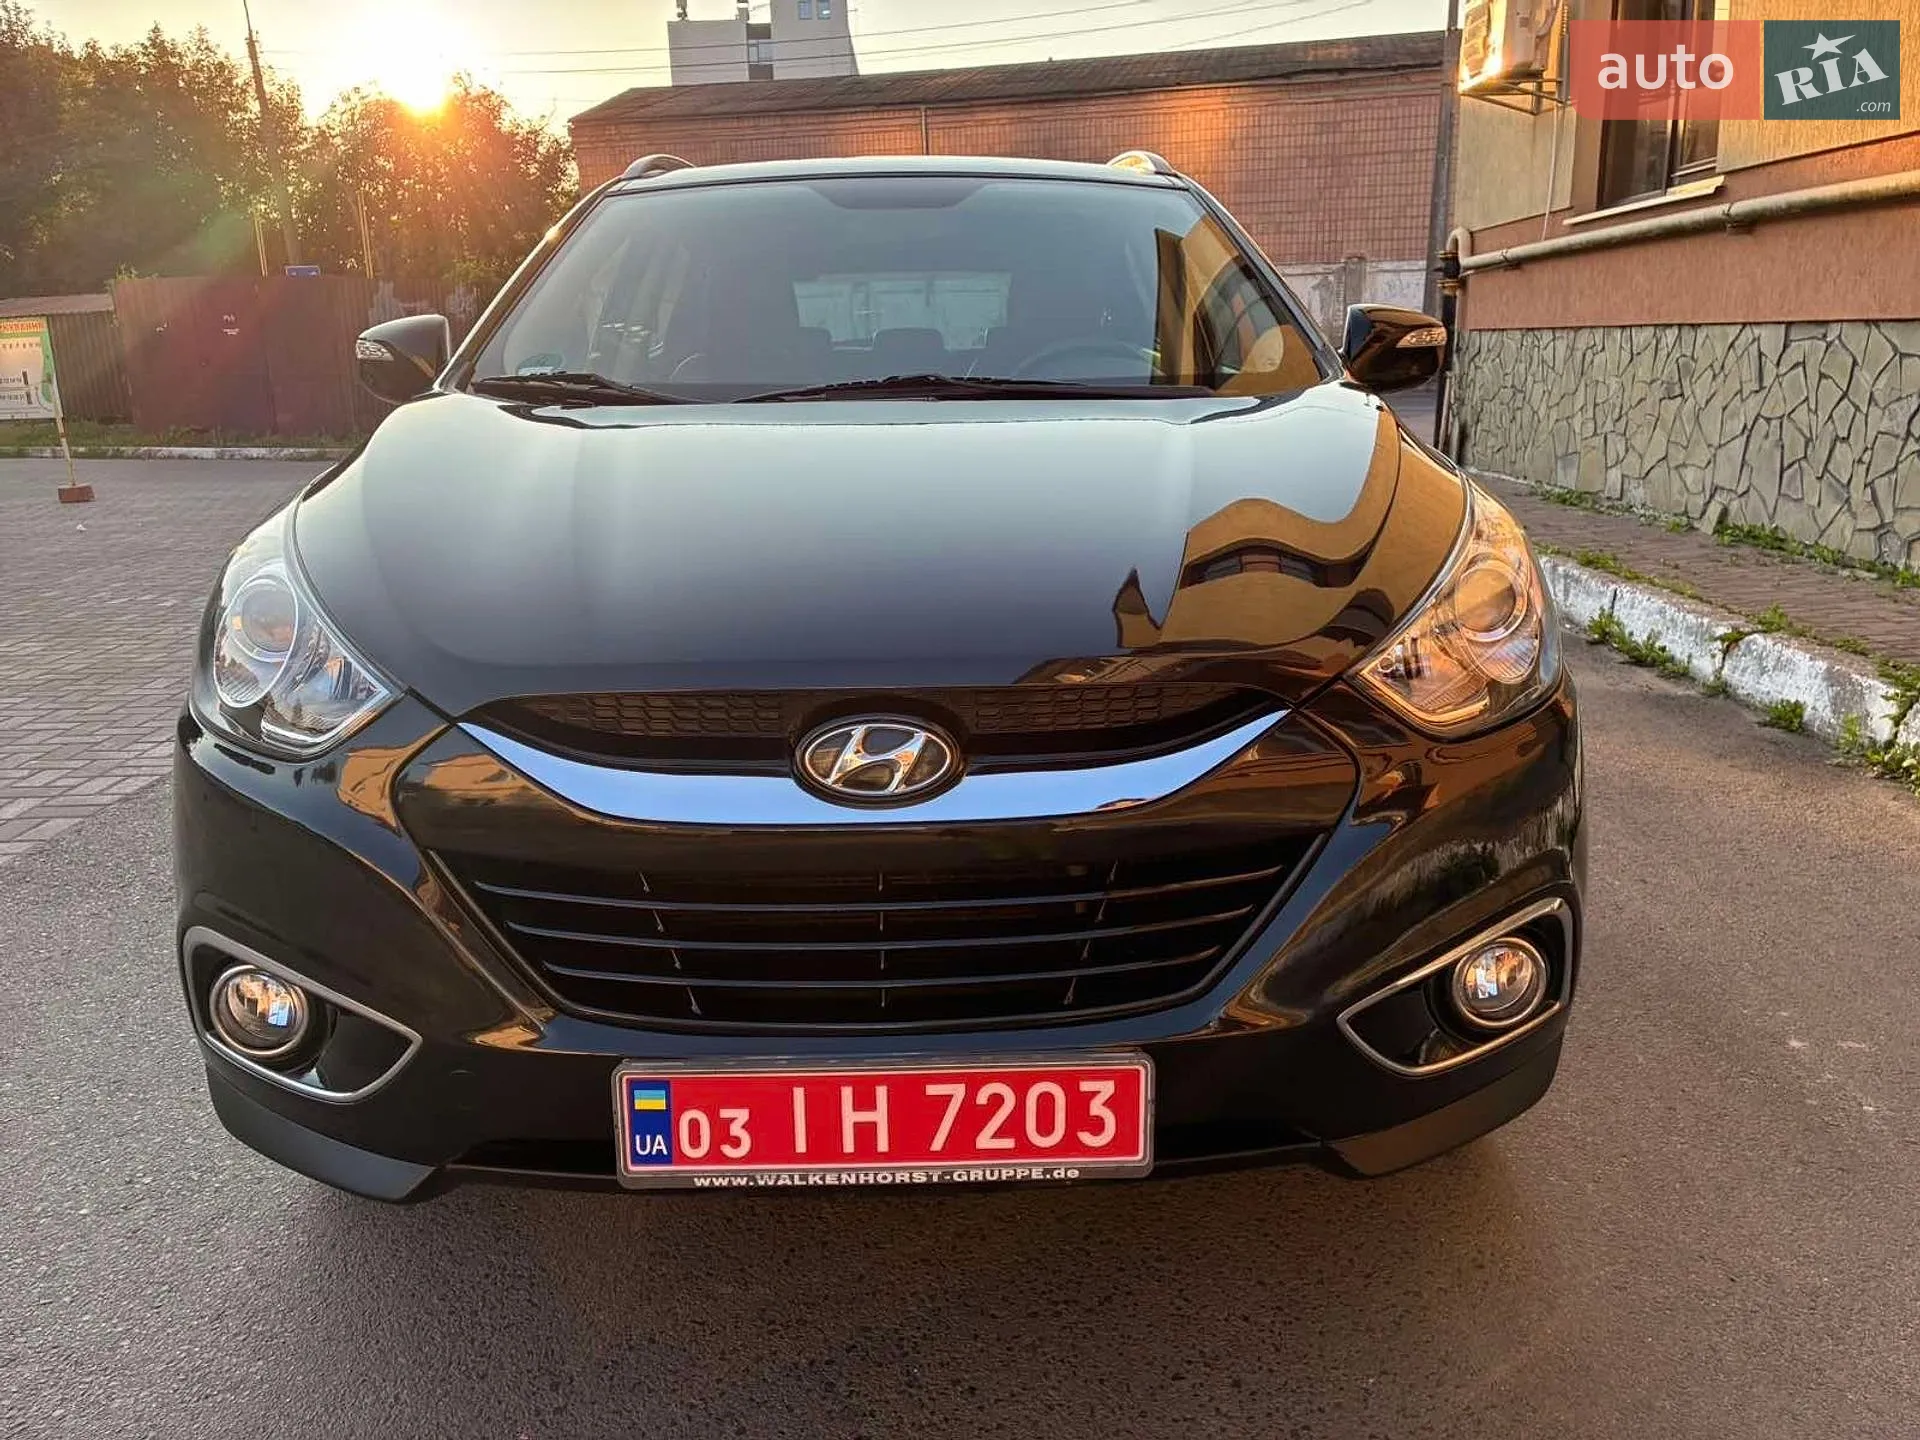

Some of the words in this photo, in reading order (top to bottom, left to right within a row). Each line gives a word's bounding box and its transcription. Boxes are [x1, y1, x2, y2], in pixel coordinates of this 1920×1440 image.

[678, 1108, 752, 1160] 03
[925, 1079, 1117, 1151] 7203
[635, 1134, 668, 1156] UA
[693, 1167, 1080, 1188] www.WALKENHORST-GRUPPE.de
